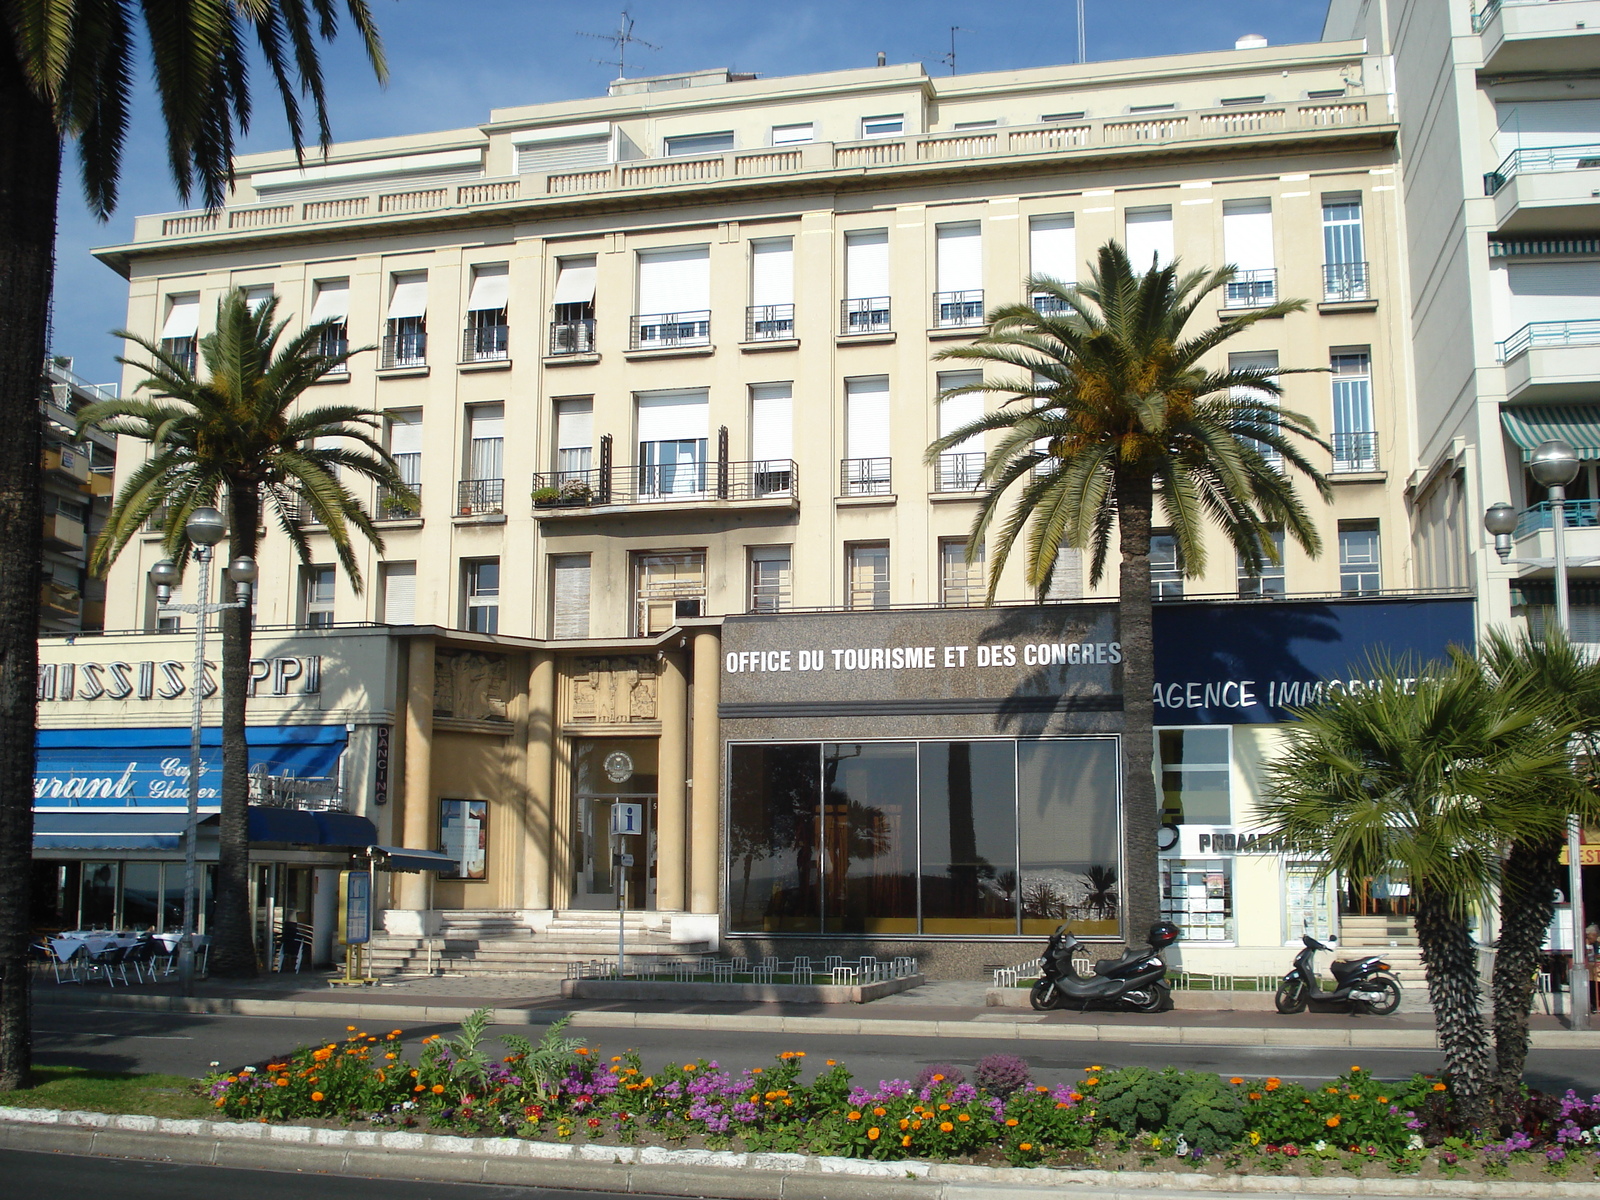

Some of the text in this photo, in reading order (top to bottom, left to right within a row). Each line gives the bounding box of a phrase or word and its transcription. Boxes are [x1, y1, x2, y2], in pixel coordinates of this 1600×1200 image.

[726, 642, 1122, 673] OFFICE DU TOURISME ET DES CONGRES
[38, 656, 320, 701] MISSISSPPI
[1153, 681, 1257, 709] AGENCE
[375, 727, 388, 803] DANCING
[149, 780, 219, 799] Glacer
